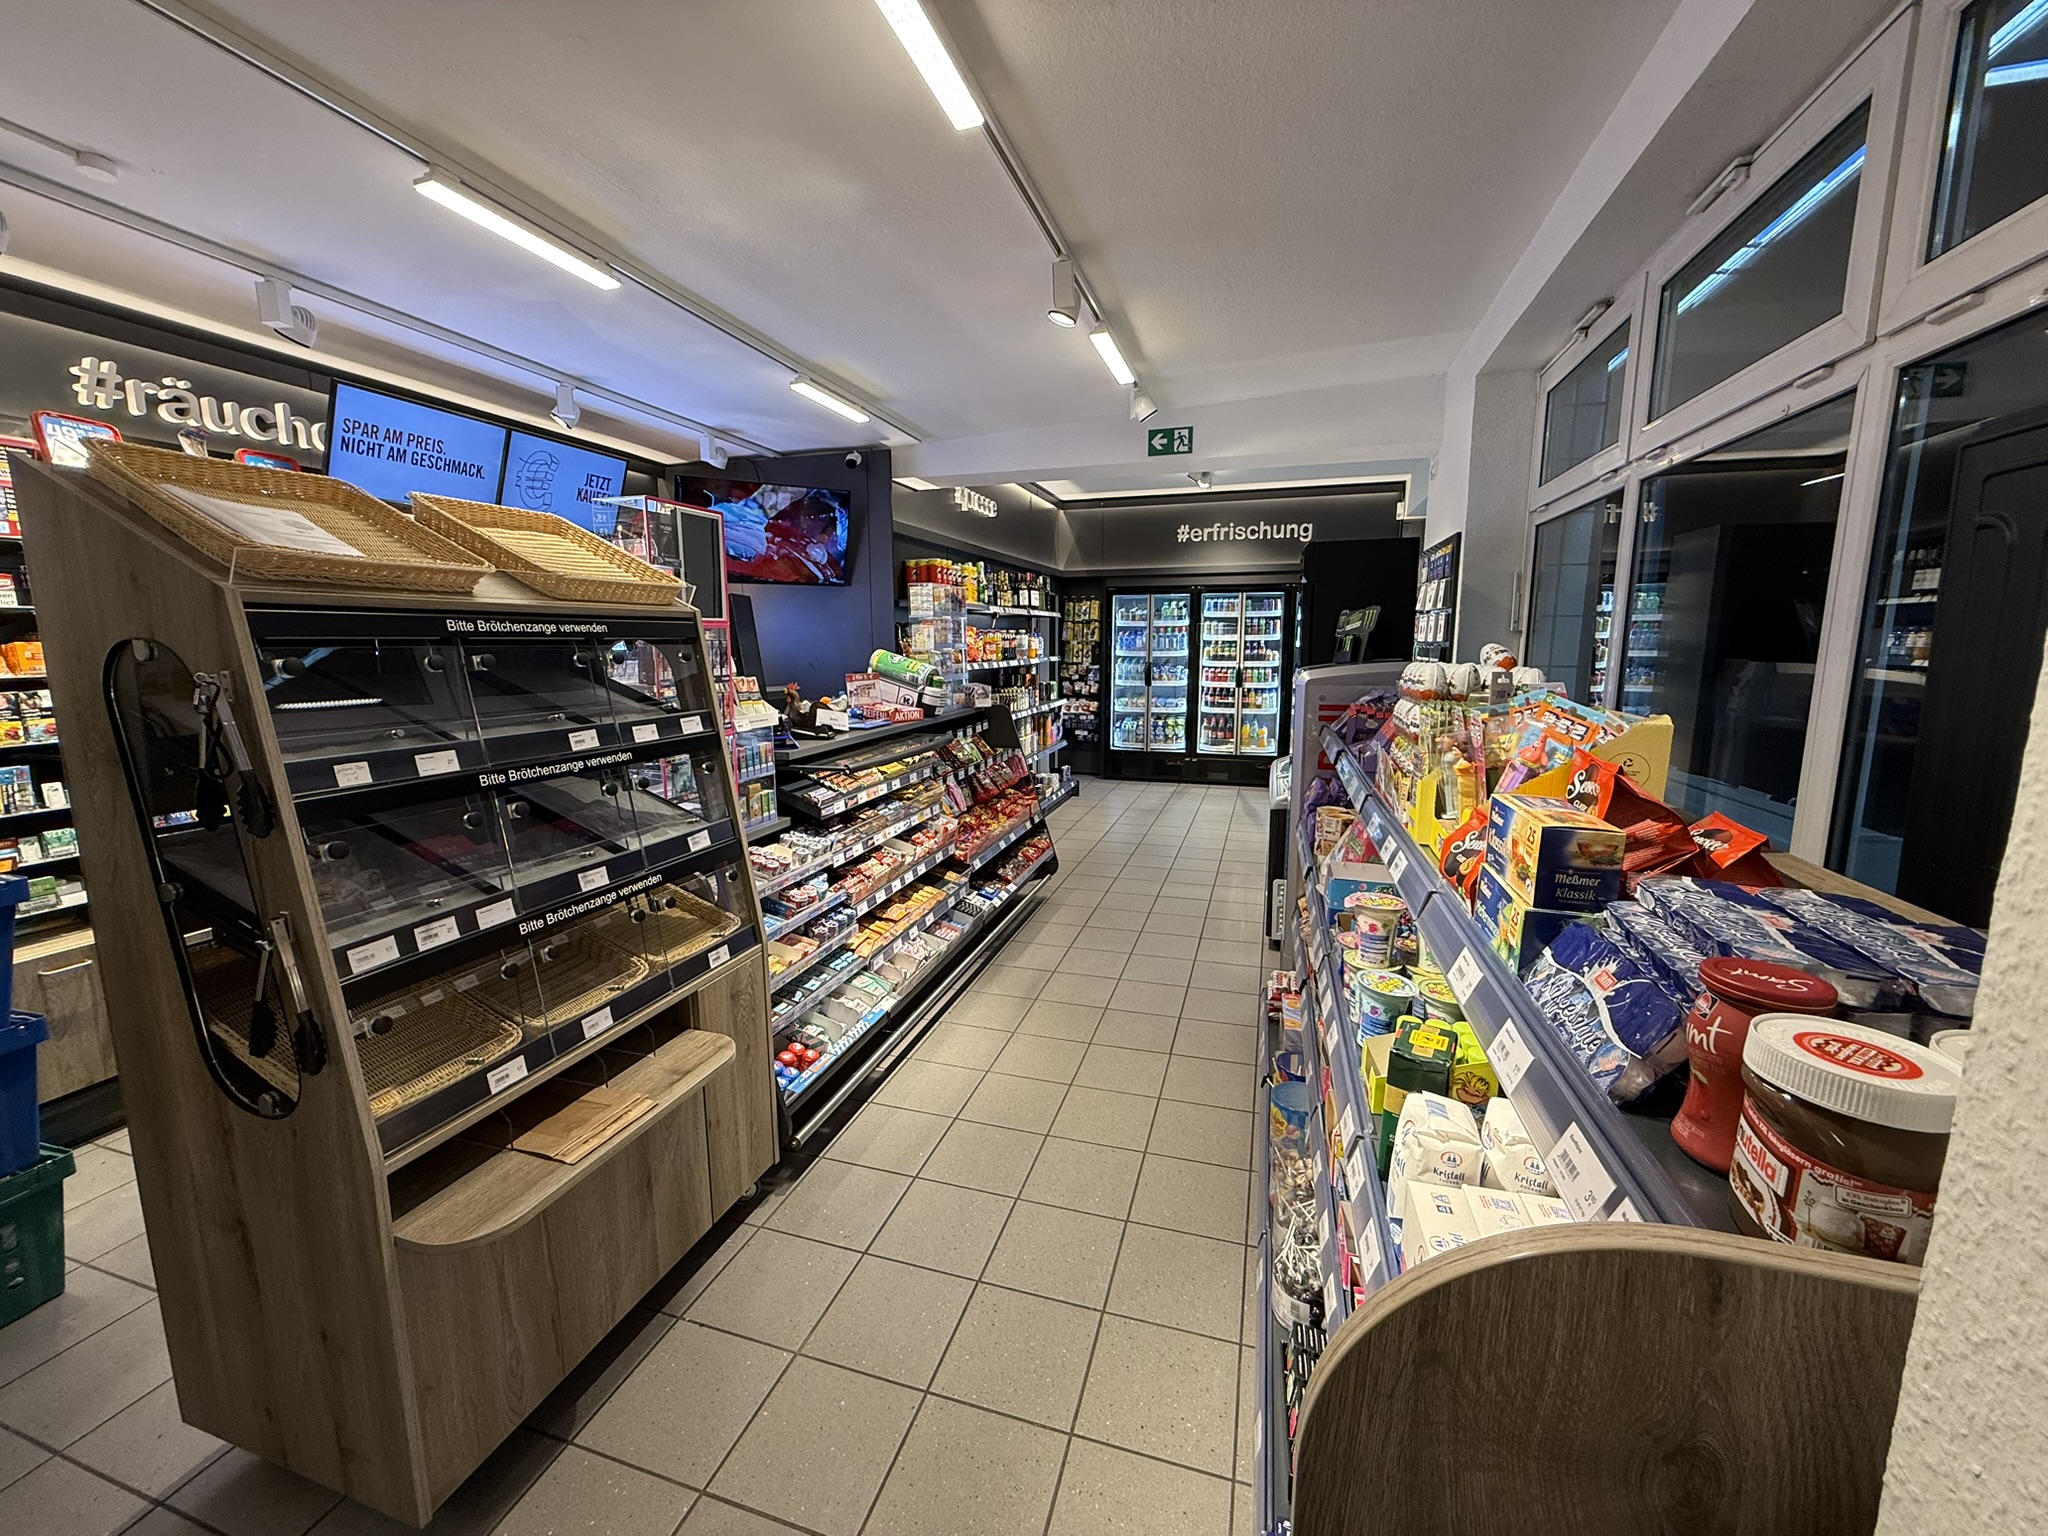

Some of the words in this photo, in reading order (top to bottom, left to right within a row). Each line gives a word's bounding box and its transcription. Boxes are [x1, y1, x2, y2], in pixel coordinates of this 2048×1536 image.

[341, 418, 379, 441] SPAR
[383, 427, 404, 445] AM
[407, 434, 447, 455] PREIS.
[340, 435, 383, 459] NICHT
[386, 447, 407, 464] AM
[411, 451, 486, 480] GESCHMACK.
[583, 473, 612, 491] JETZT
[576, 487, 614, 508] KAUFEN
[1176, 520, 1314, 542] #erfrischung
[446, 618, 474, 632] Bitte
[476, 619, 557, 636] Brötchenzange
[558, 622, 608, 634] verwenden
[894, 709, 920, 721] AKTION
[479, 771, 507, 787] Bitte
[508, 761, 584, 784] Brötchenzange
[585, 750, 633, 769] verwenden
[1527, 826, 1537, 846] 25
[1554, 873, 1601, 887] Meßmer
[1555, 887, 1596, 901] Klassik
[518, 918, 545, 936] Bitte
[546, 889, 617, 926] Brötchenzange
[617, 873, 663, 897] verwenden
[1510, 907, 1520, 927] 25
[1726, 967, 1816, 993] Samt
[1736, 1124, 1777, 1184] nutella
[1768, 1130, 1812, 1169] Keksgläsern
[1433, 1166, 1466, 1182] Kristall
[1514, 1172, 1549, 1190] Kristall
